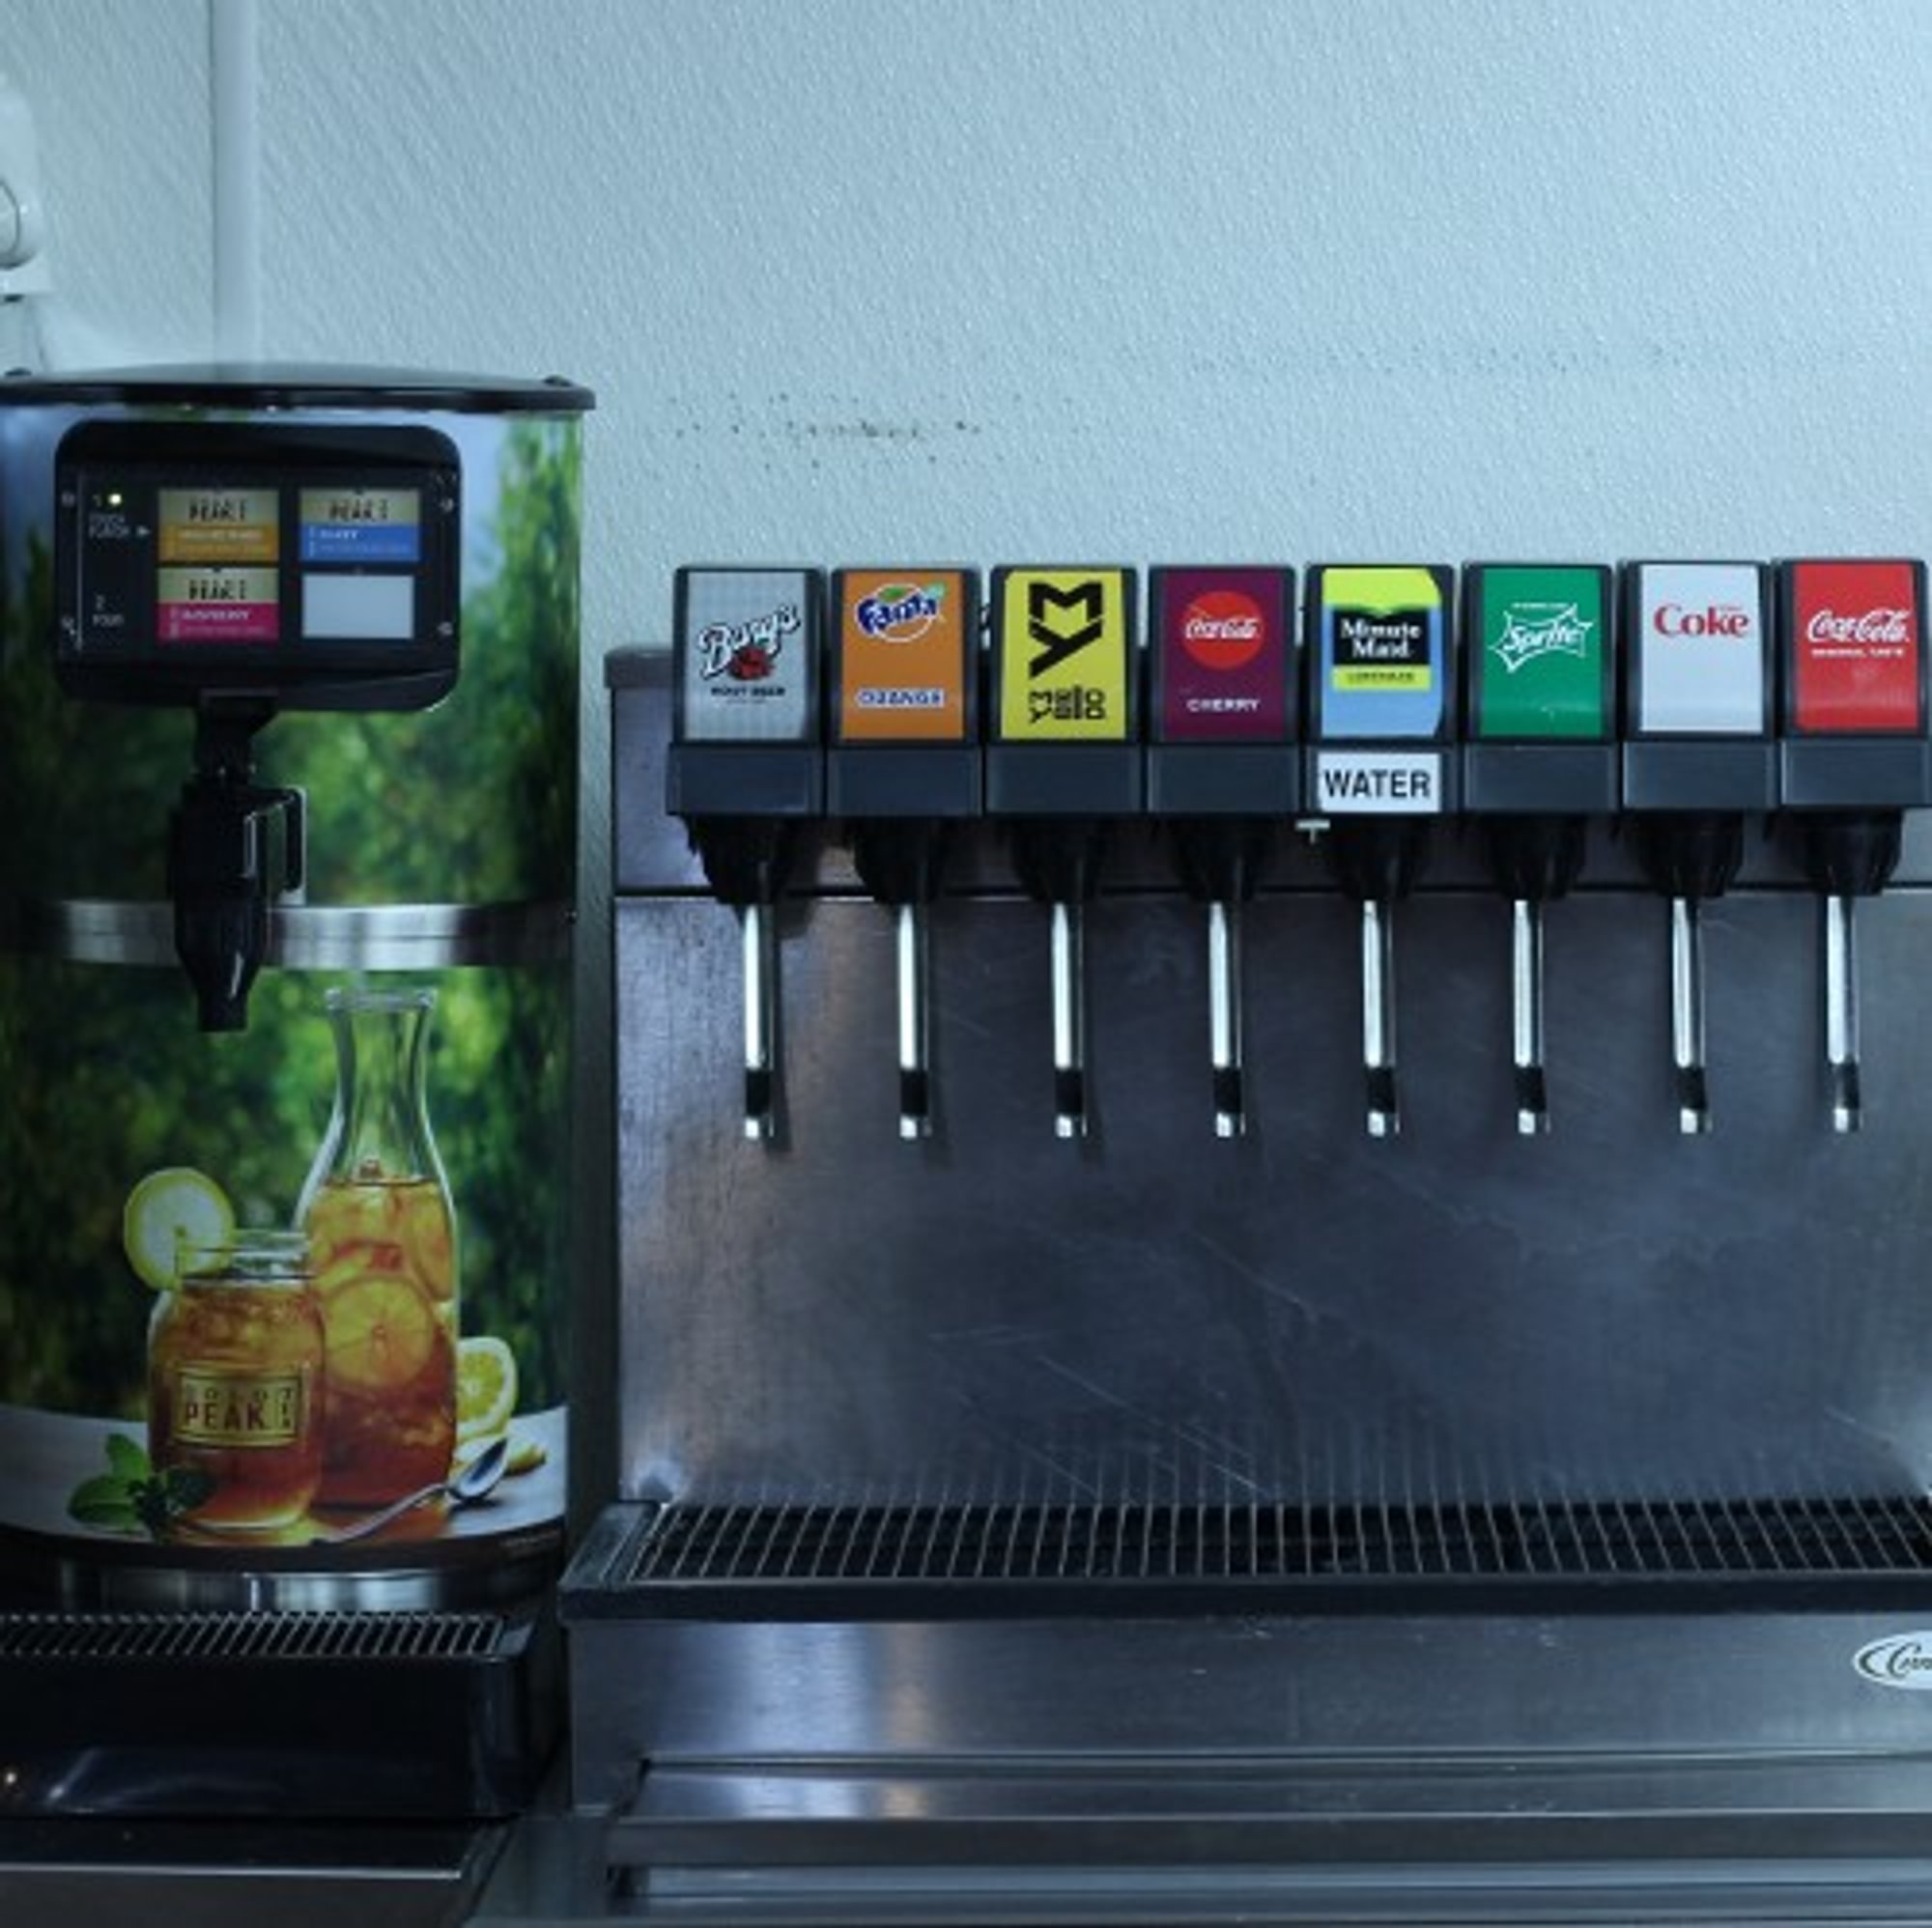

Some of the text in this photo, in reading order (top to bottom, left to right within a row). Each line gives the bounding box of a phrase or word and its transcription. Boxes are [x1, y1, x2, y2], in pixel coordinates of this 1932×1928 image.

[855, 593, 939, 636] Fanta
[1340, 617, 1422, 639] Minute
[1653, 602, 1749, 638] Coke
[1807, 607, 1911, 644] Coca-Cola
[1352, 637, 1411, 659] Maid
[1502, 618, 1580, 655] Sprite
[858, 689, 943, 706] ORANGE
[1185, 697, 1261, 713] CHERRY
[1324, 769, 1432, 798] WATER
[185, 1401, 265, 1431] PEAK
